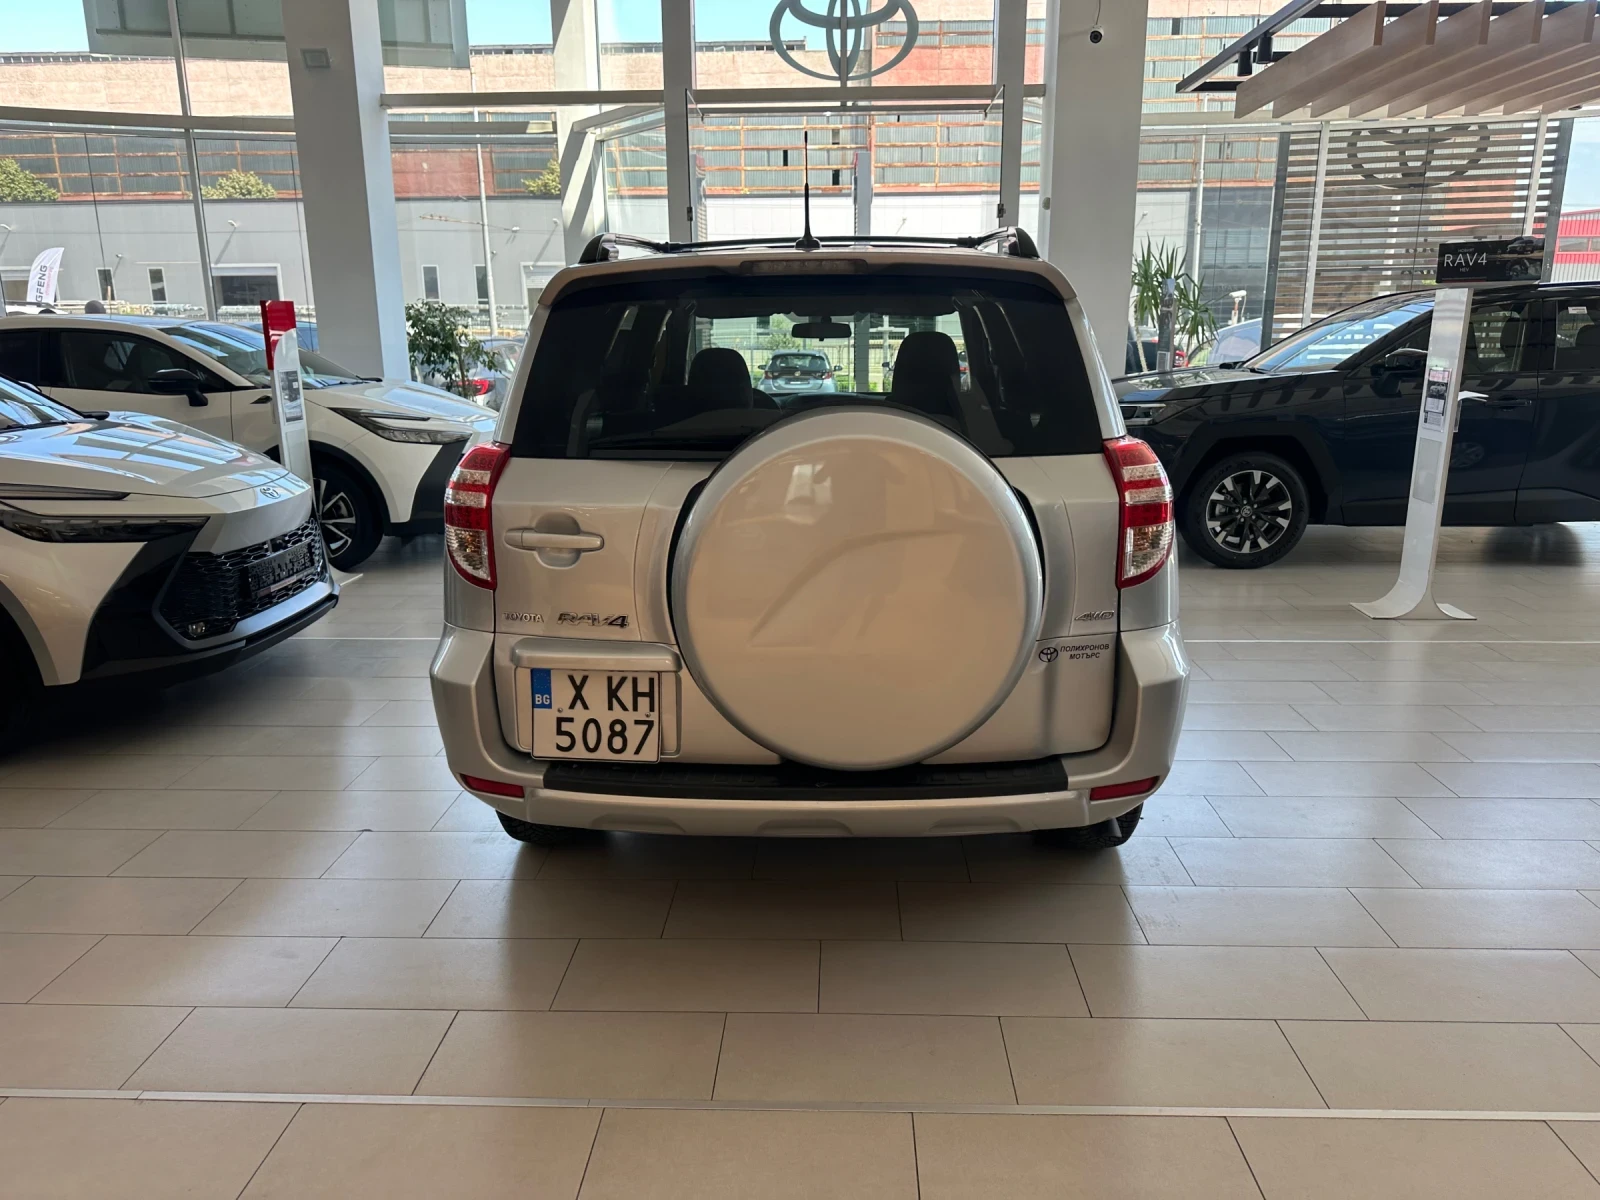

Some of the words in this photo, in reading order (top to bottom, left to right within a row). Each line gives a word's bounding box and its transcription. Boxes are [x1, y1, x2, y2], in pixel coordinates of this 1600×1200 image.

[1443, 252, 1487, 267] RAV4
[503, 612, 545, 623] TOYOTA
[556, 612, 630, 628] RAV4
[1060, 643, 1110, 652] ПОЛИХРОНОВ
[1069, 652, 1100, 660] МОТЪРС
[534, 694, 551, 705] BG
[555, 716, 655, 756] 5087
